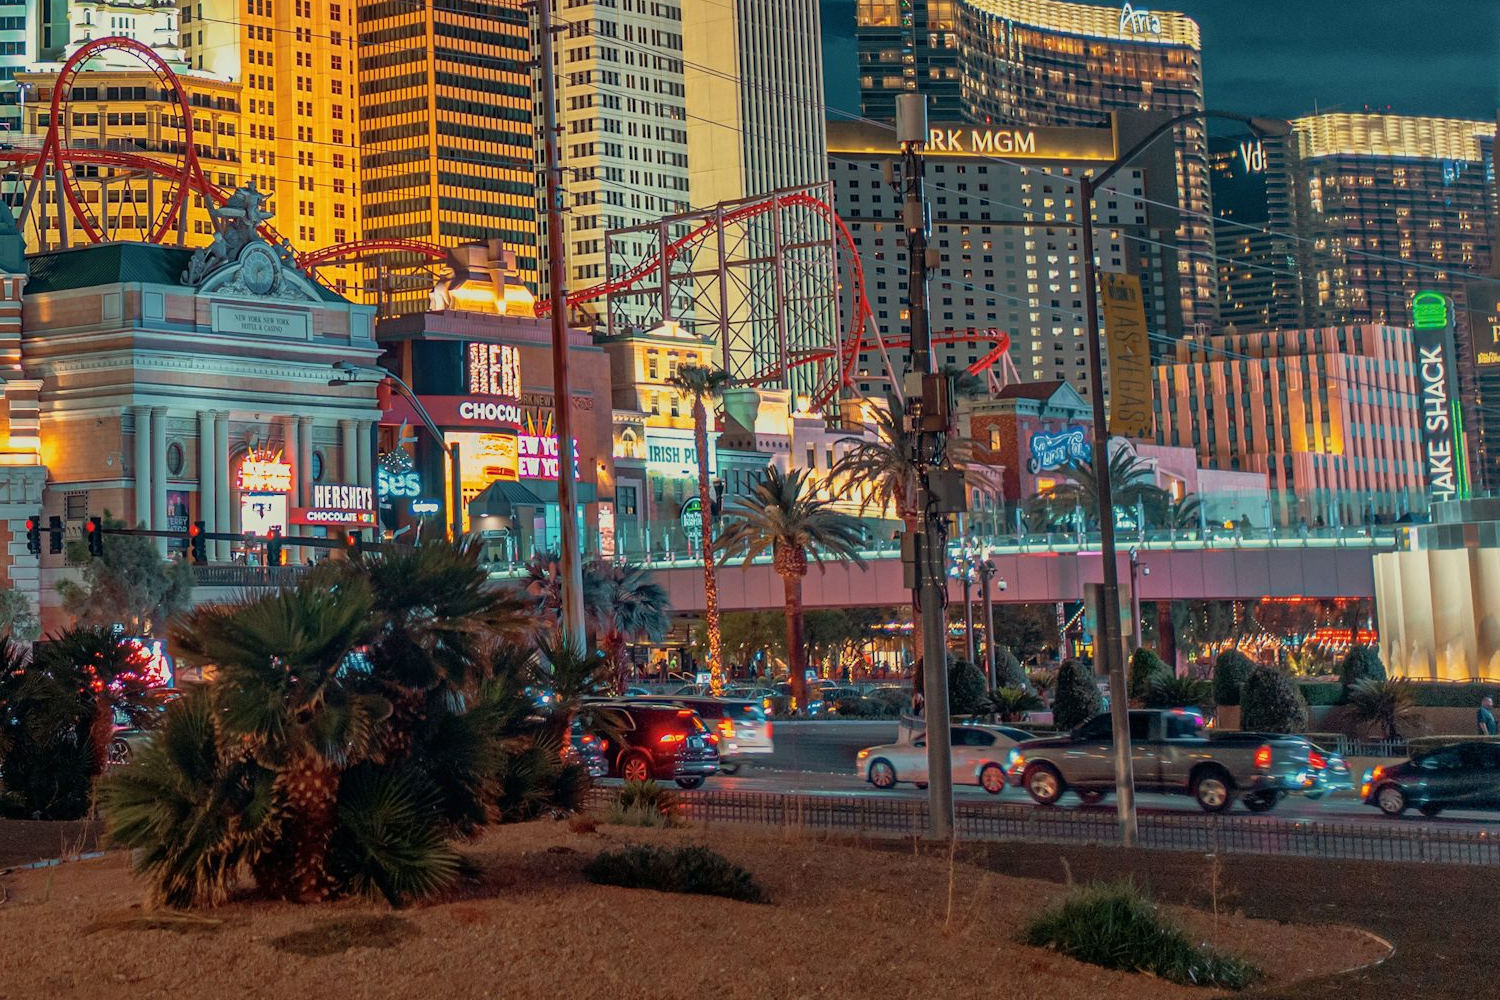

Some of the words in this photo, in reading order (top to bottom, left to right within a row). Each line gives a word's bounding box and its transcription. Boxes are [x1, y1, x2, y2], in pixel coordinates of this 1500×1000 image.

[1120, 2, 1161, 37] Aria
[924, 128, 963, 151] RK
[972, 129, 1036, 153] MGM
[1116, 353, 1146, 423] VEGAS
[1420, 344, 1449, 432] SHACK
[518, 436, 539, 454] EW
[540, 437, 580, 457] YOK
[649, 445, 680, 463] IRISH
[684, 448, 699, 464] PU
[518, 457, 540, 476] EW
[541, 458, 581, 479] YOK
[1428, 439, 1456, 502] HAKE
[306, 511, 358, 522] CHOCOLATE
